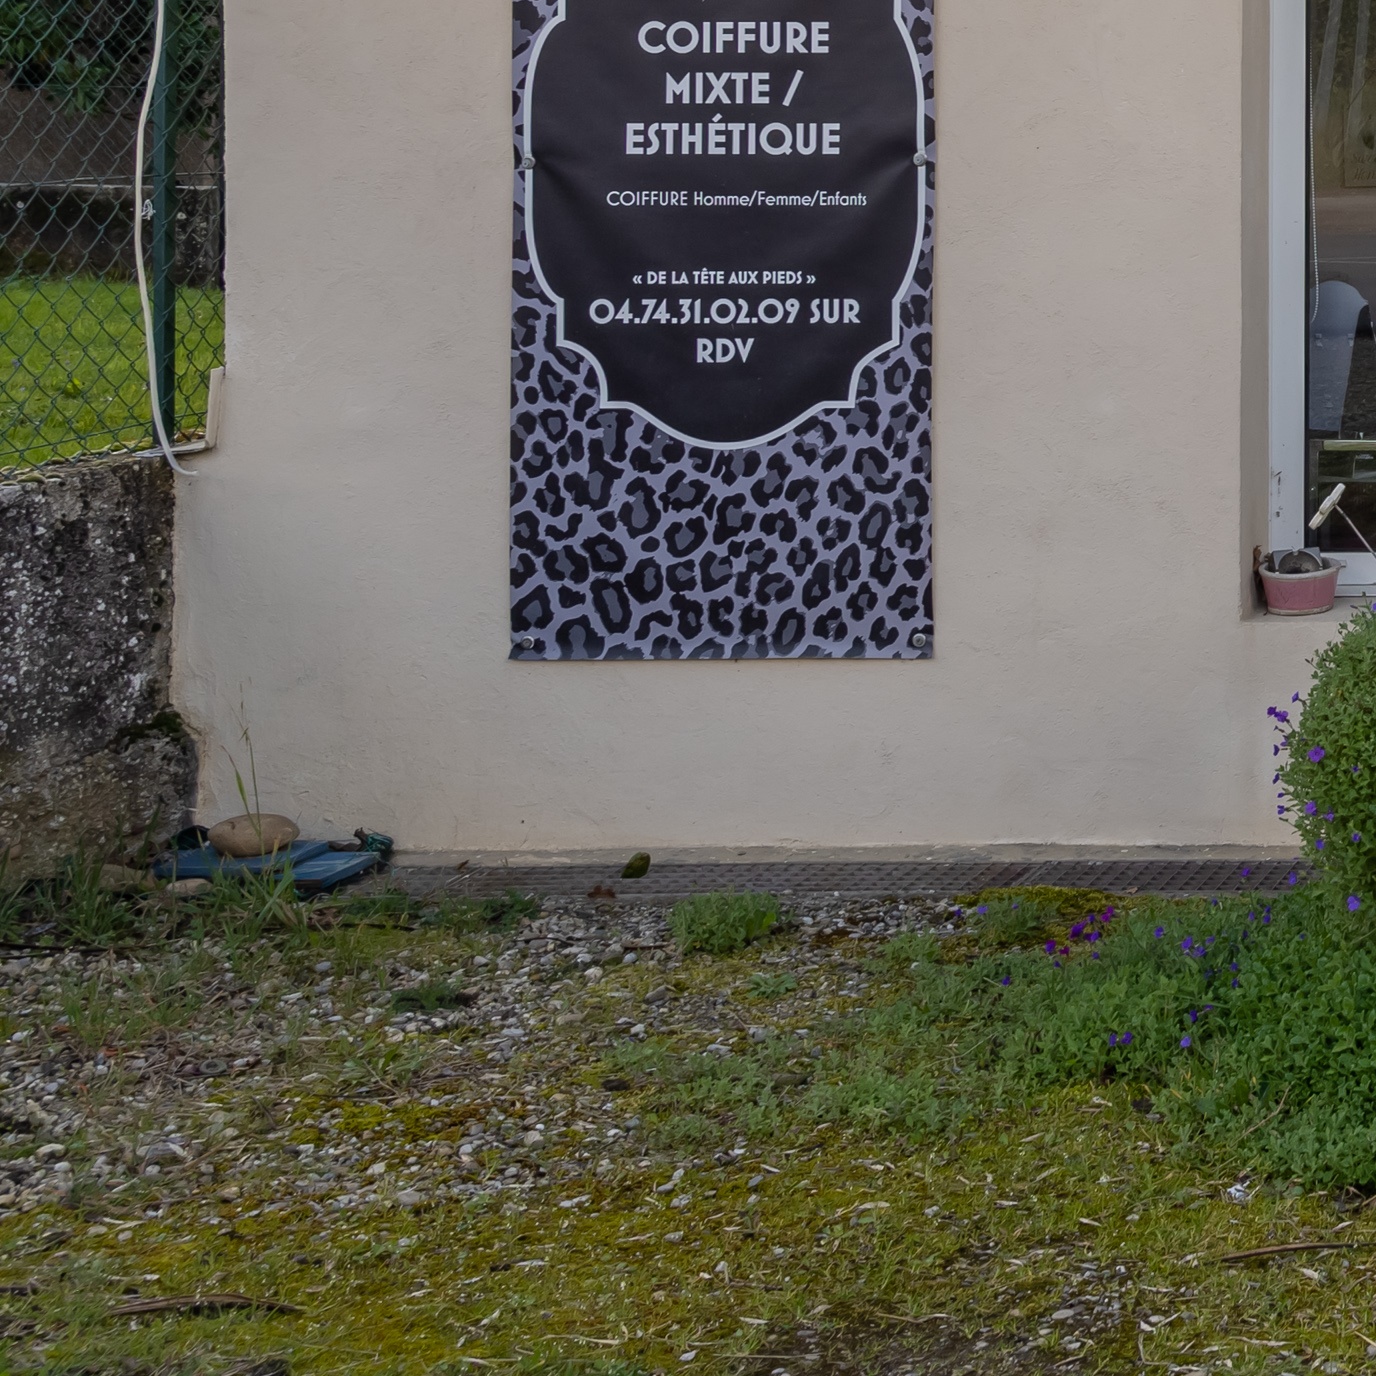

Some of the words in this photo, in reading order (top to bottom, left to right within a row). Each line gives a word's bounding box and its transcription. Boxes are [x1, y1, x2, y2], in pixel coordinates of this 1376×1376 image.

[637, 20, 830, 55] COIFFURE
[665, 71, 771, 105] MIXTE
[625, 112, 842, 156] ESTHÉTIQUE
[606, 190, 688, 207] COIFFURE
[694, 189, 868, 207] Homme/Femme/Enfants
[646, 270, 667, 285] DE
[671, 270, 689, 285] LA
[693, 267, 725, 285] TÊTE
[727, 270, 759, 285] AUX
[762, 270, 804, 285] PIEDS
[589, 297, 801, 325] 04.74.31.02.09
[809, 297, 861, 325] SUR
[696, 337, 756, 364] RDV
